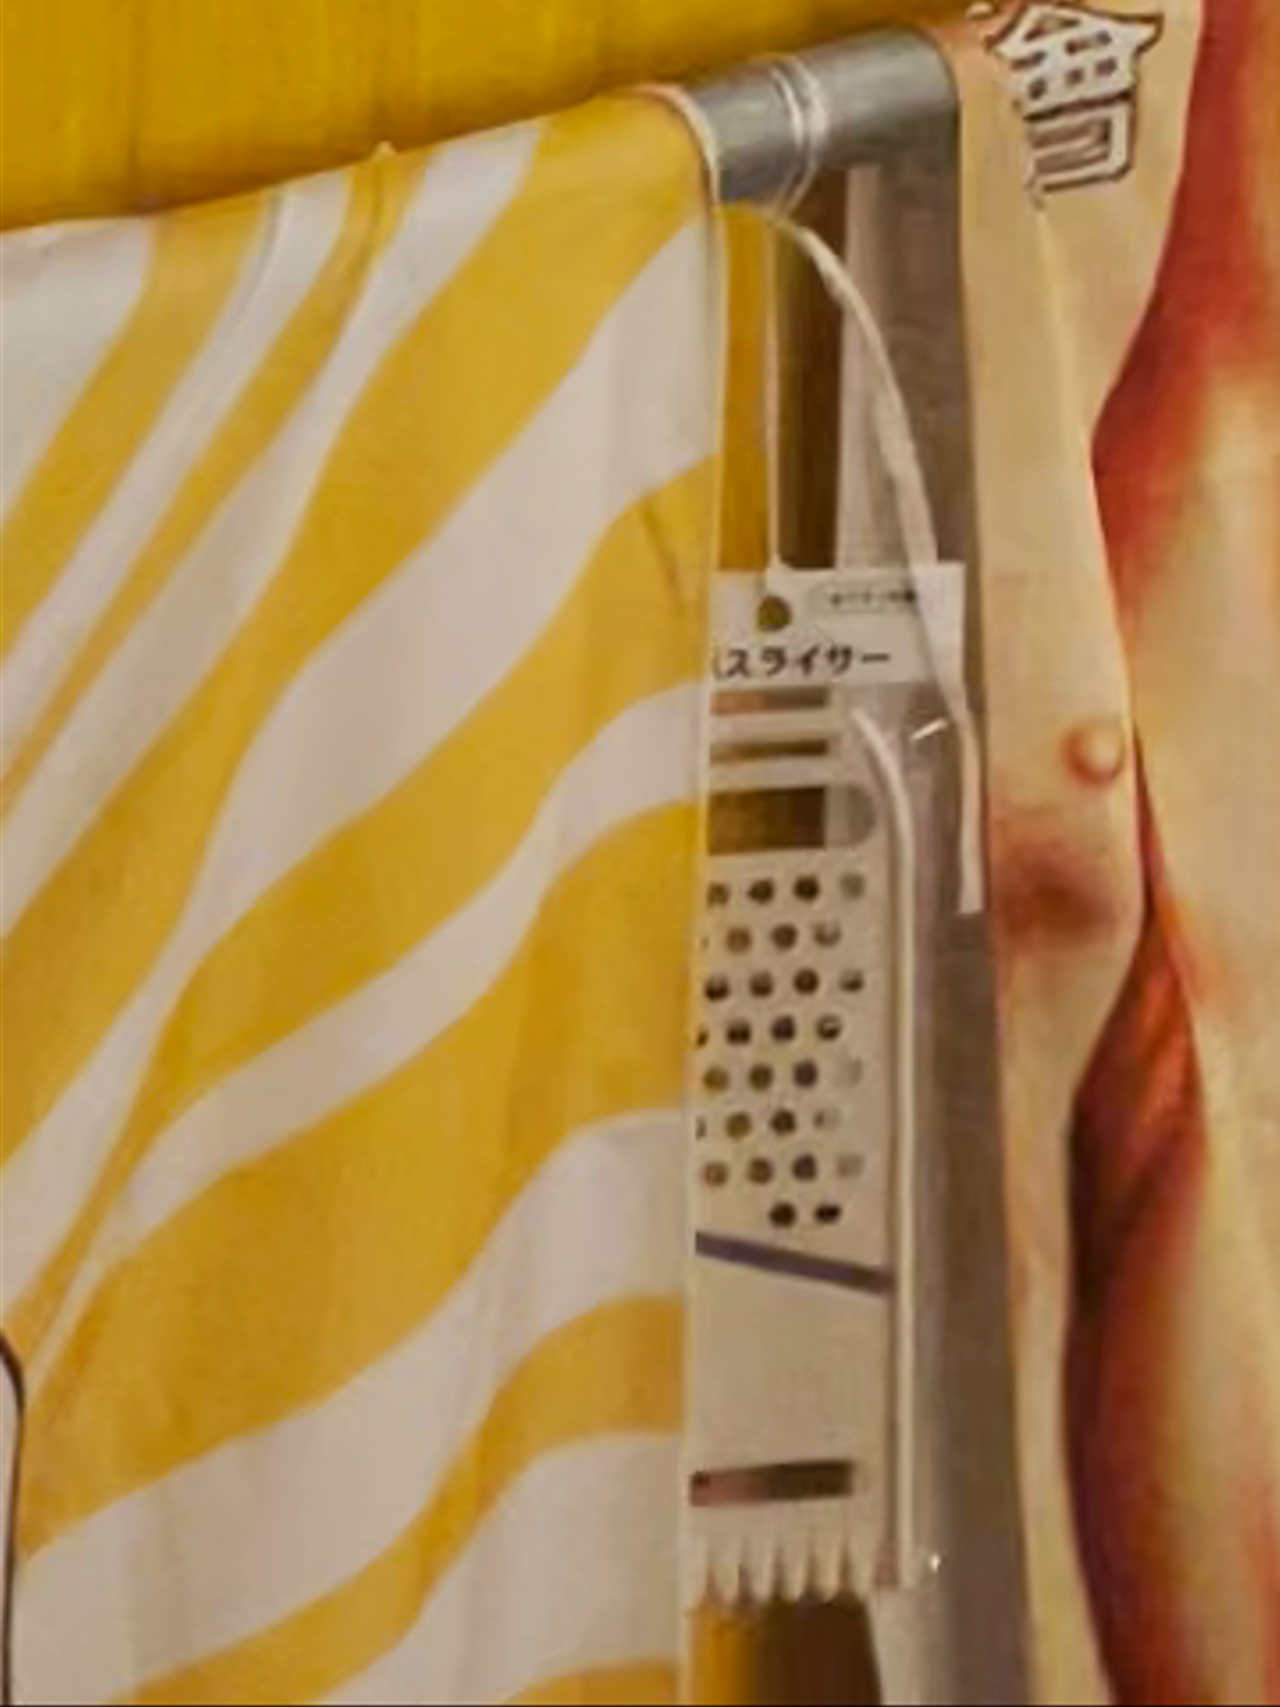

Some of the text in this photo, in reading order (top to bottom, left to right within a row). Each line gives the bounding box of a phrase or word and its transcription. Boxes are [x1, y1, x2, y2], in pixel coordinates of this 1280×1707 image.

[711, 644, 891, 678] スライサー
